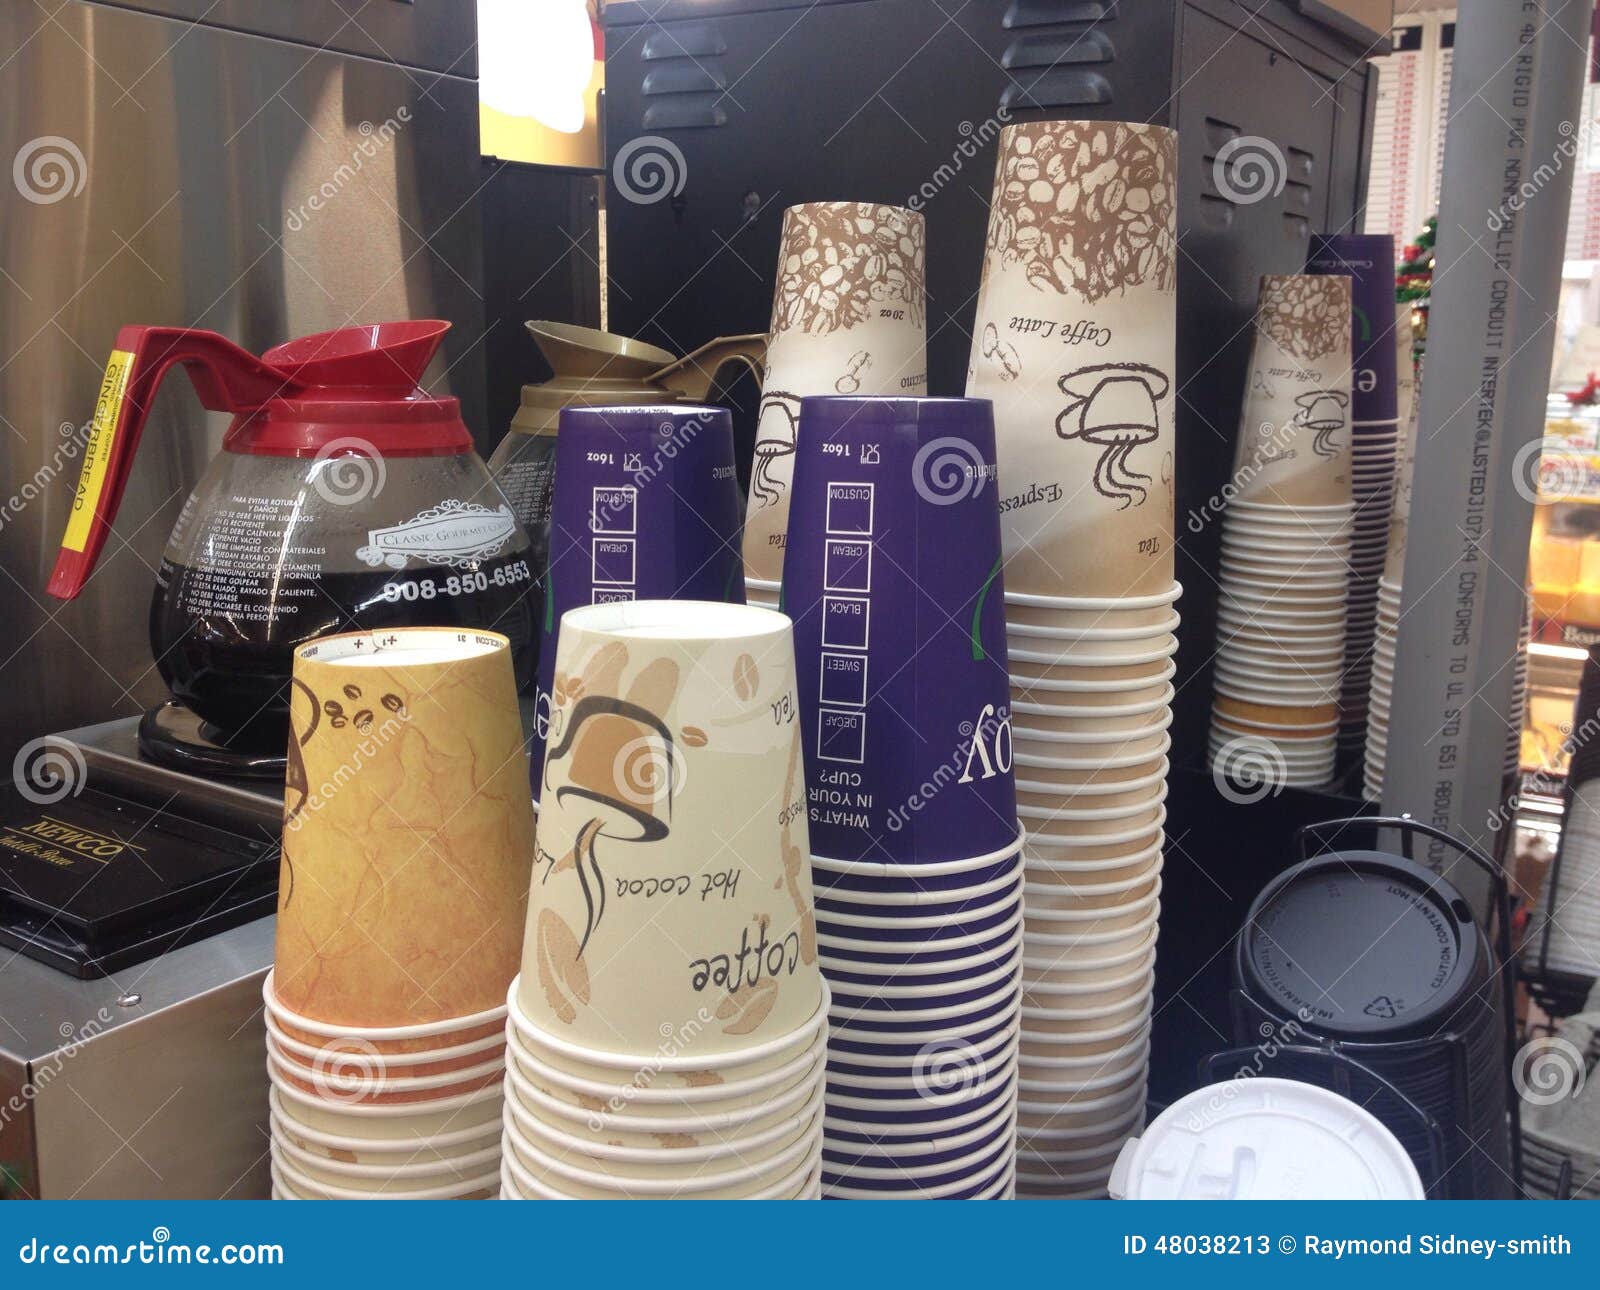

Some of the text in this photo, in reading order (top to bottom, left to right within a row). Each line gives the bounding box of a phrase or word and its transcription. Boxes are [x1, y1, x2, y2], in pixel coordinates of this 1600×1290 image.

[1514, 54, 1535, 110] RIGID
[1508, 117, 1527, 148] PVC
[1485, 279, 1508, 348] CONDUIT
[1010, 316, 1112, 347] Caffe Latte
[74, 364, 117, 511] GINGERBREAD
[587, 452, 614, 464] 16oz
[822, 443, 850, 457] 16oz
[596, 493, 633, 504] CUSTOM
[830, 488, 871, 500] CUSTOM
[999, 483, 1063, 514] Espress
[600, 543, 628, 553] CREAM
[832, 545, 863, 557] CREAM
[1138, 536, 1160, 554] Tea
[383, 559, 531, 602] 908-850-6553
[830, 602, 861, 614] BLACK
[1452, 572, 1477, 646] CONFORMS
[827, 659, 860, 672] SWEET
[1450, 657, 1467, 674] TO
[1446, 682, 1464, 700] UL
[771, 690, 797, 725] Tea
[825, 716, 857, 729] DECAF
[1442, 707, 1460, 737] STD
[819, 768, 862, 787] CUP?
[809, 787, 873, 808] IN YOUR
[810, 807, 870, 828] WHAT'S
[21, 821, 124, 856] NEWCO
[616, 869, 741, 901] Hot cocoa
[1384, 884, 1411, 900] HOT
[1430, 944, 1450, 990] CAUTION
